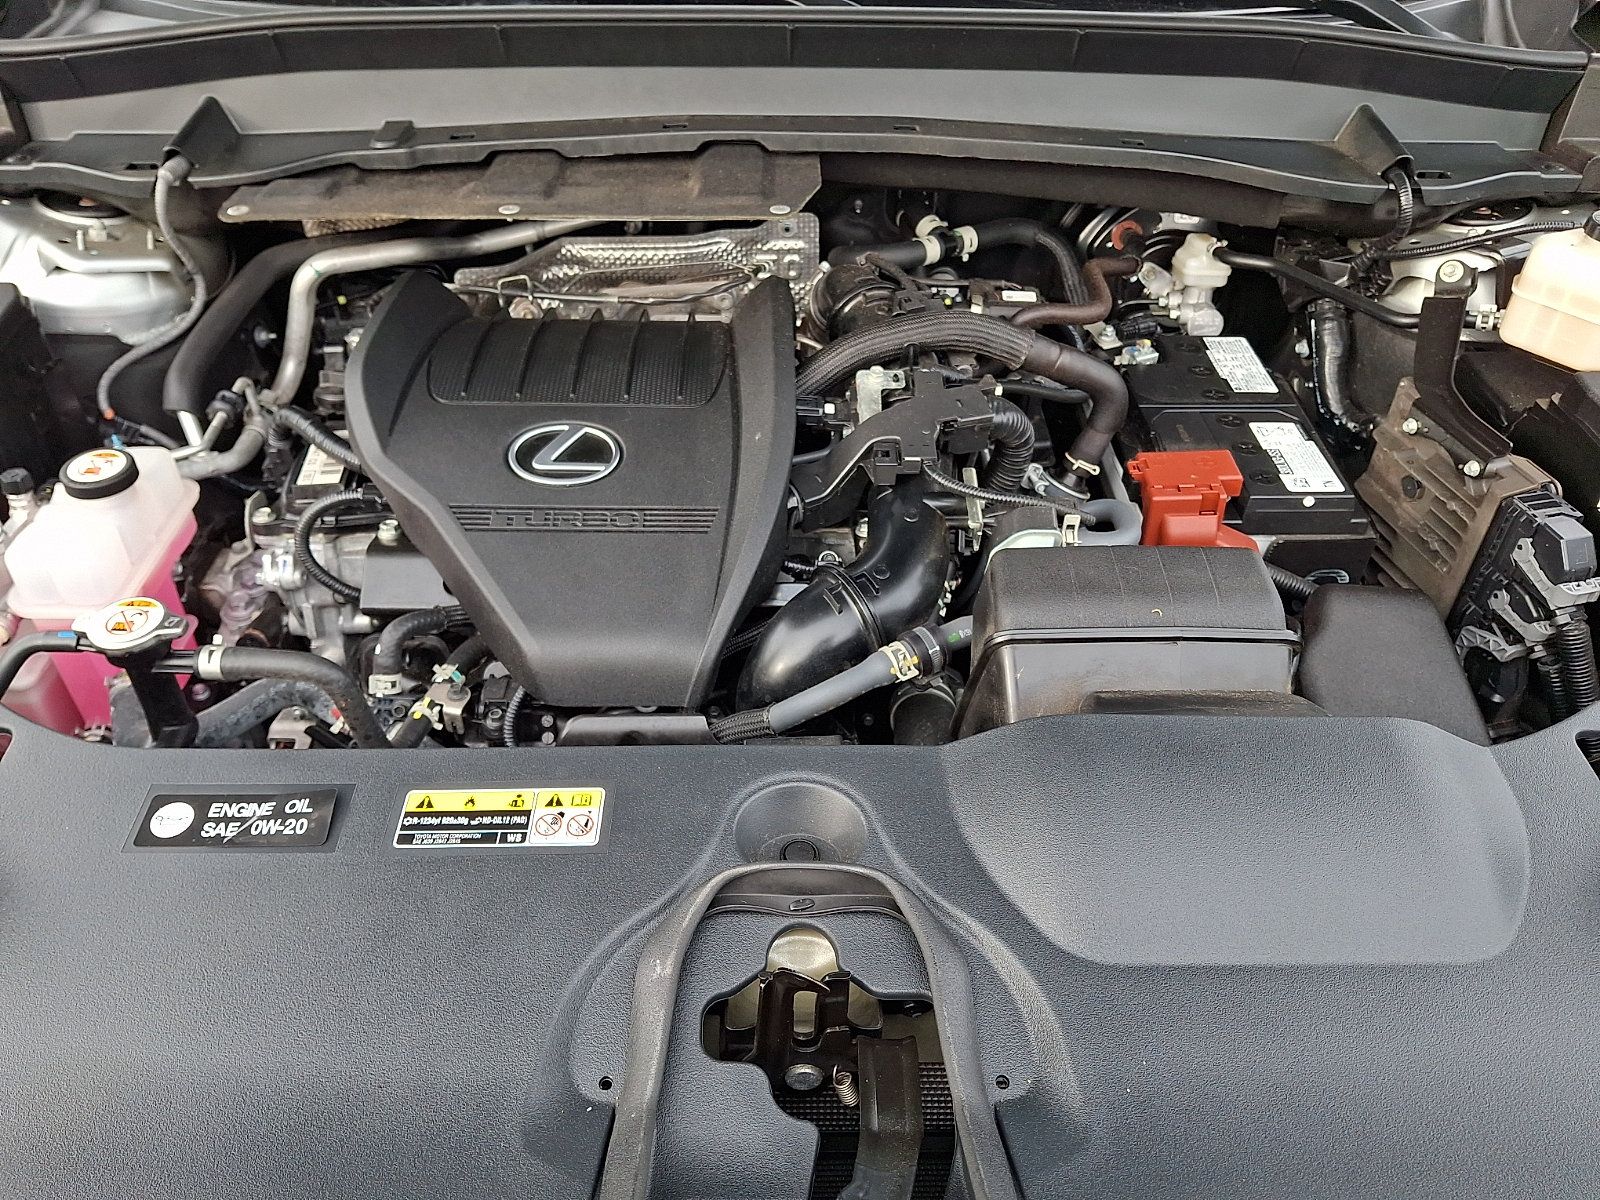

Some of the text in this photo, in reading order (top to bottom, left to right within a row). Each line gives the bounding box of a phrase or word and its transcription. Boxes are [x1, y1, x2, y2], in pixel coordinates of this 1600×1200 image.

[494, 509, 641, 528] TURBO
[207, 798, 313, 818] ENGINE OIL
[200, 818, 308, 838] SAE 0W-20
